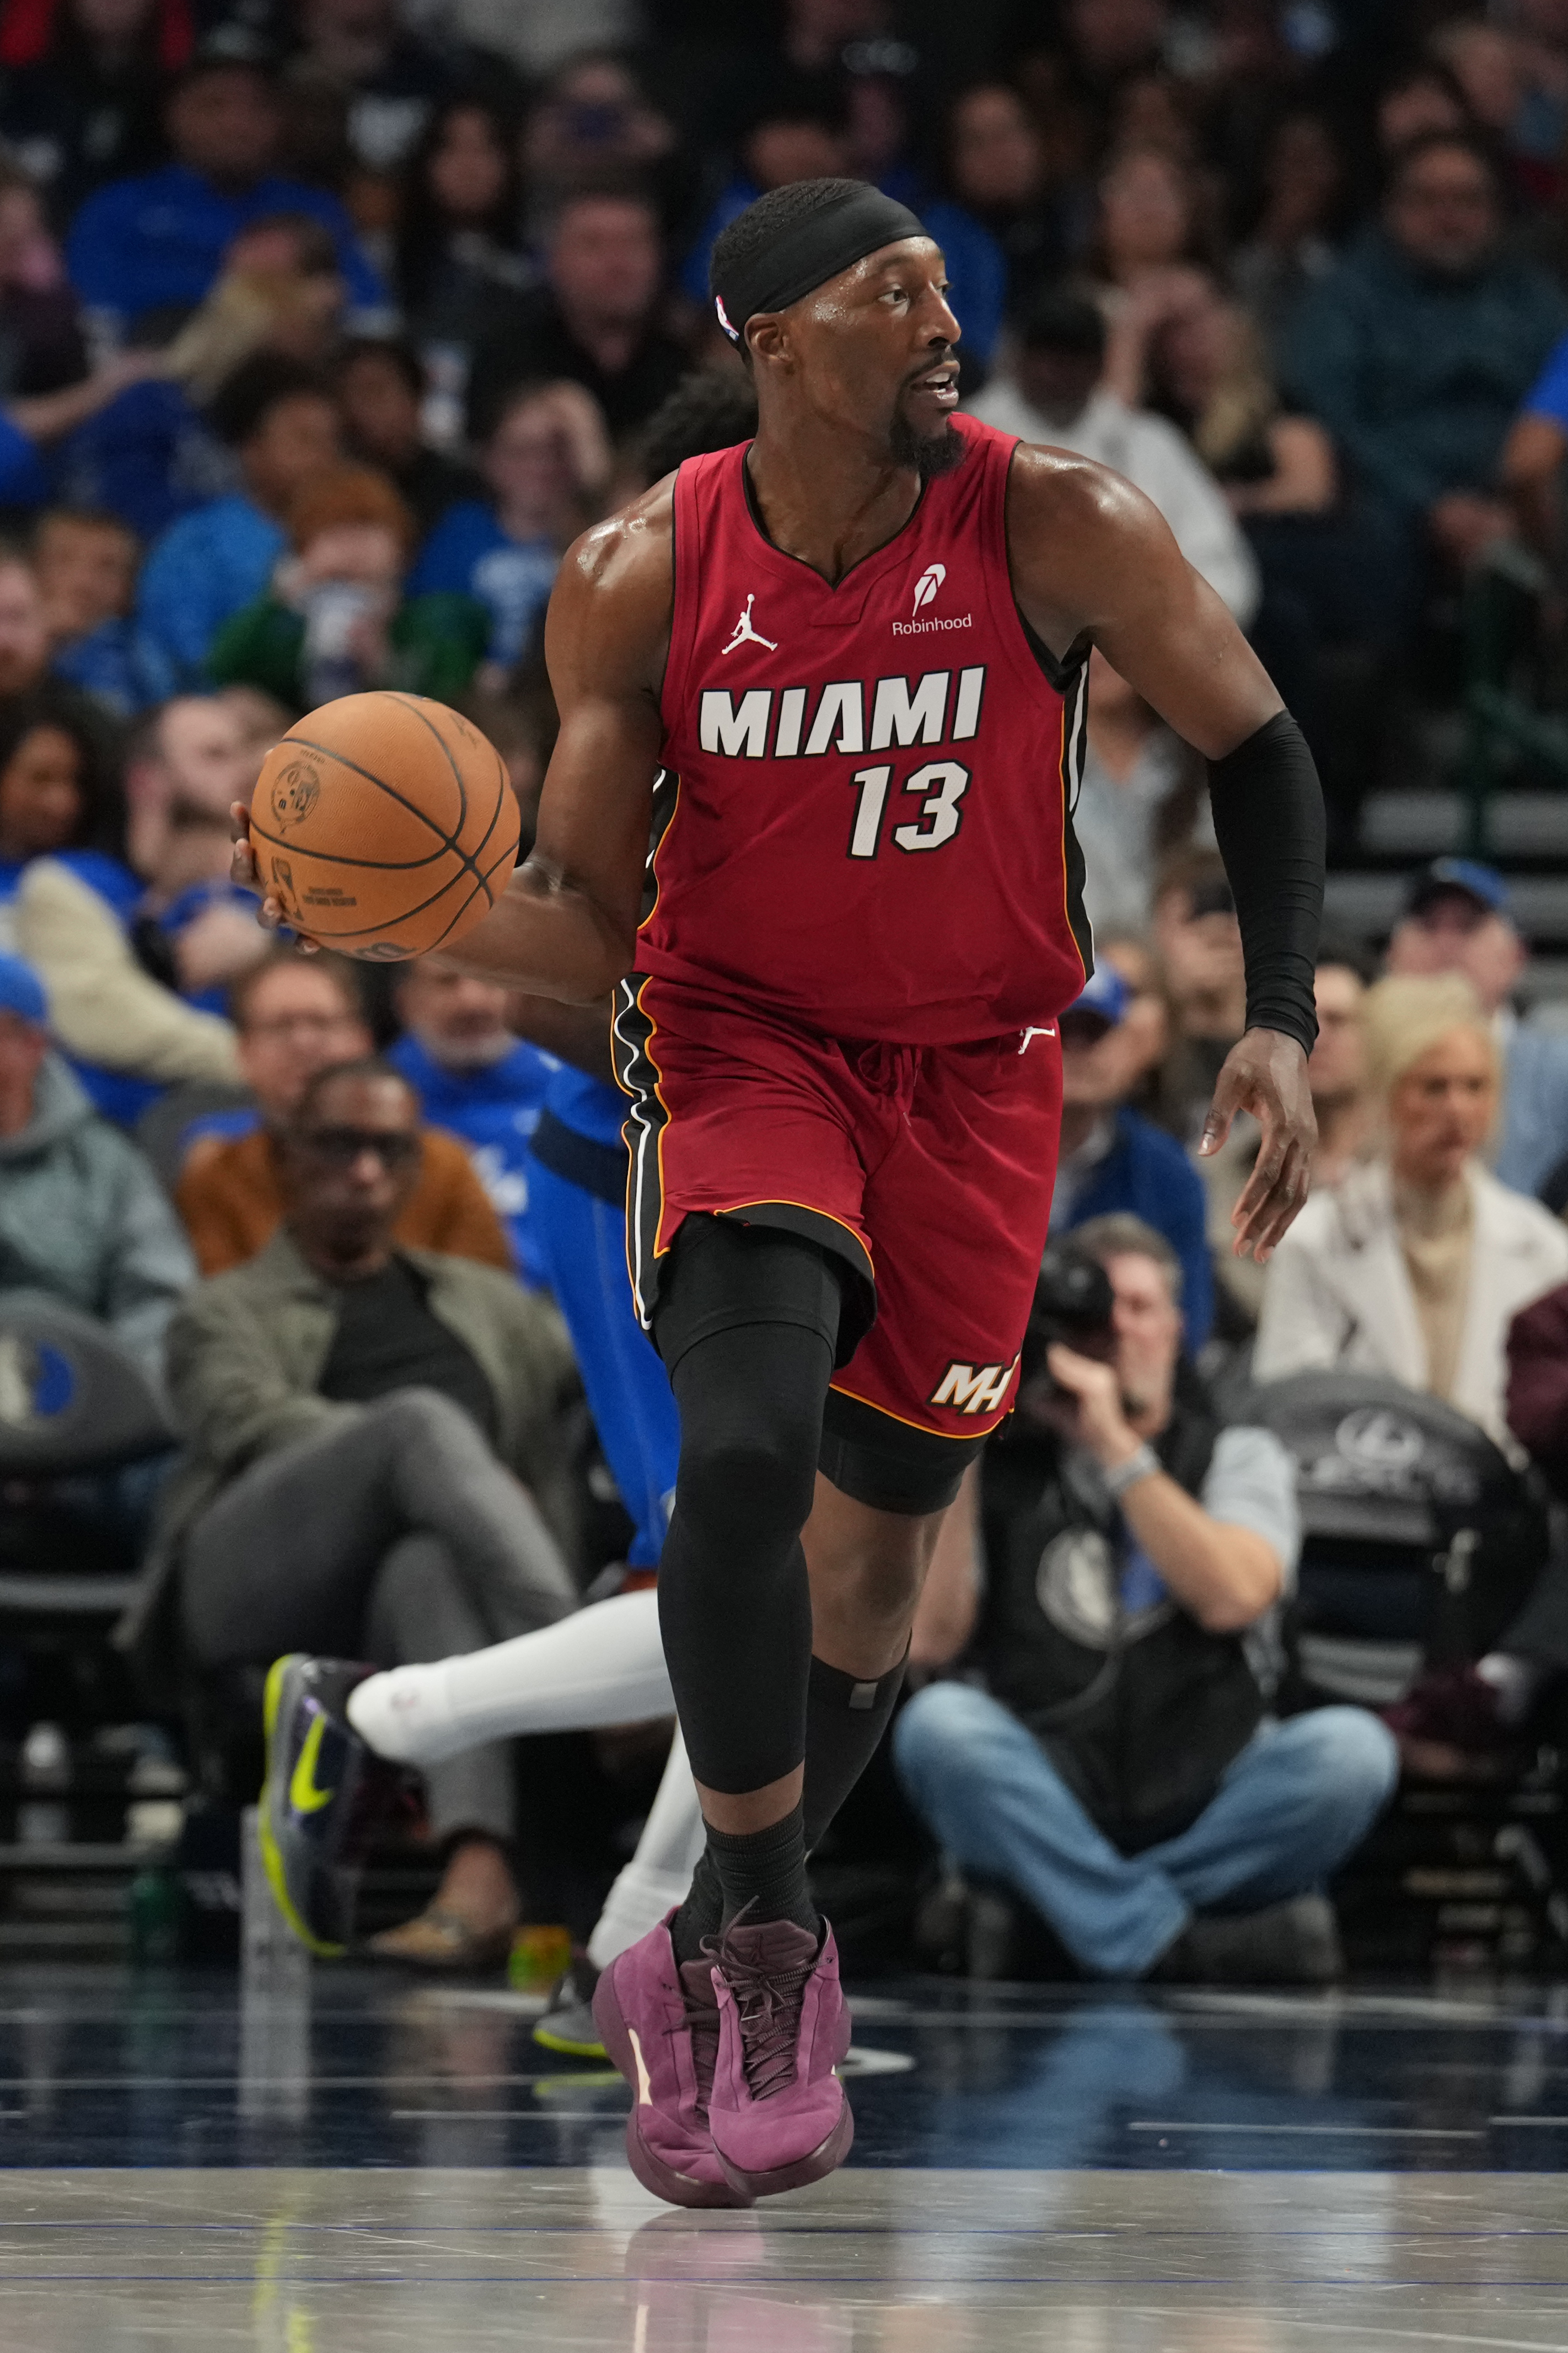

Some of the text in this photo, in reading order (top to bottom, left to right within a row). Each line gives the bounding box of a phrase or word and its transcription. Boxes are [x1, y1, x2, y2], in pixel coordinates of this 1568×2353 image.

[892, 614, 972, 636] Robinhood
[698, 664, 986, 759] MIAMI
[846, 759, 972, 860] 13
